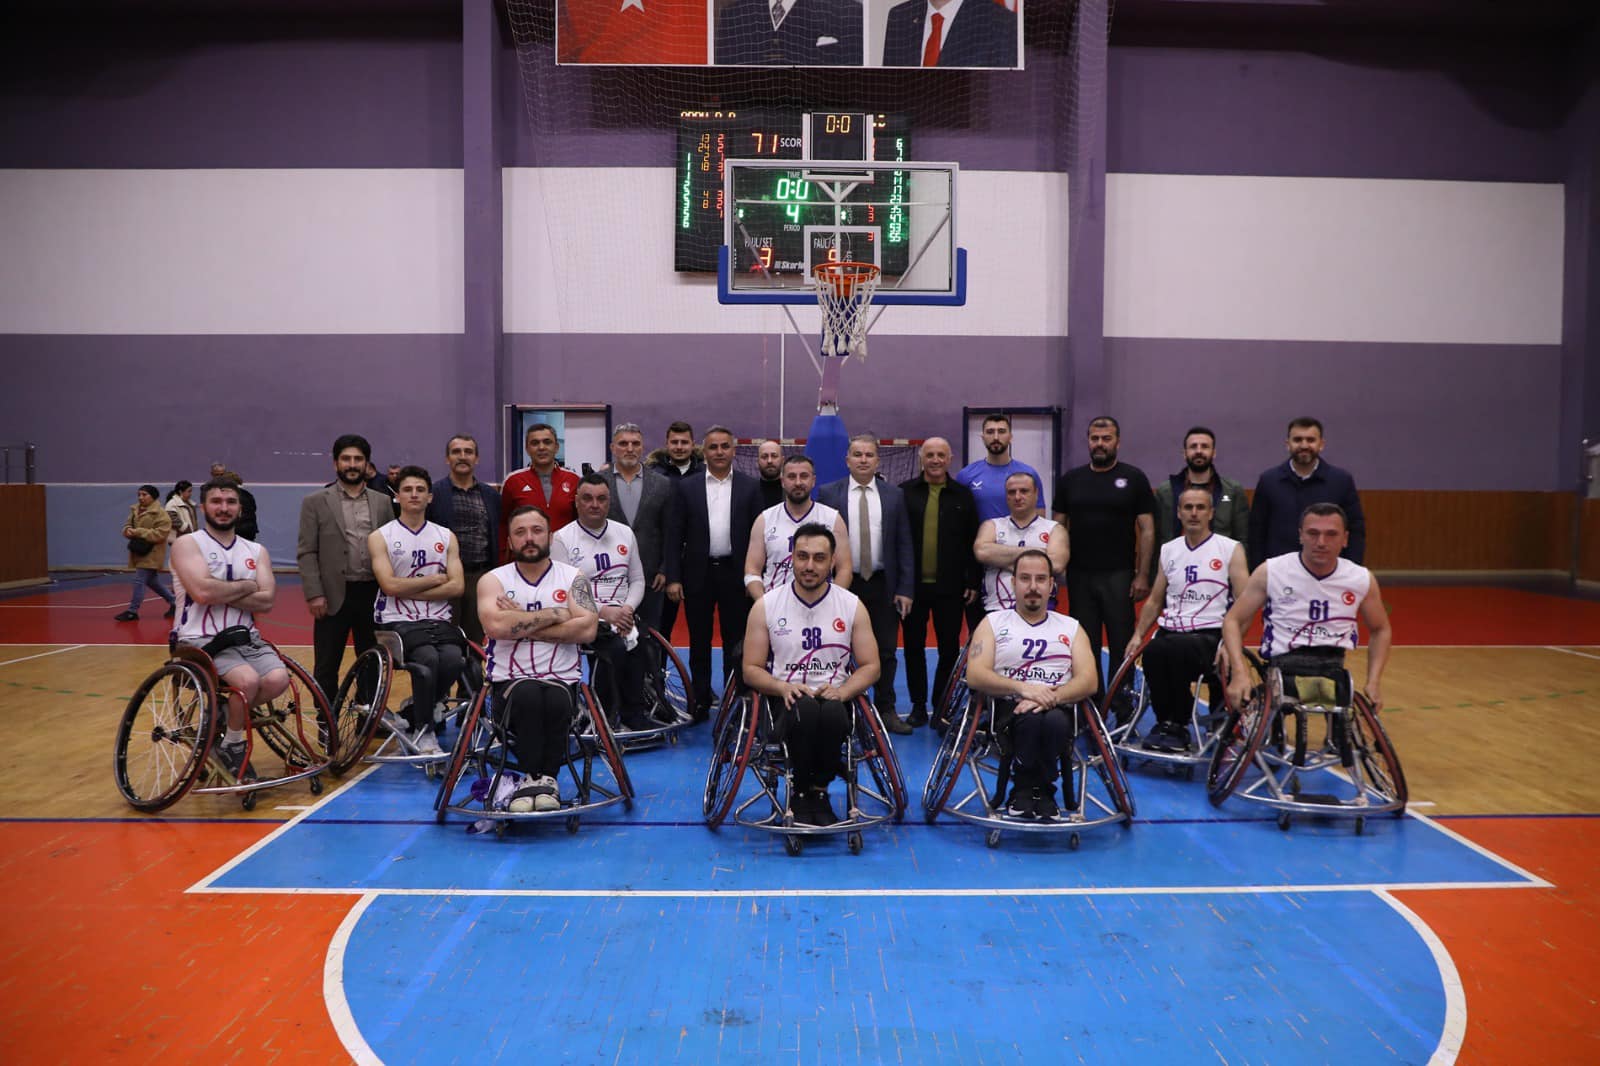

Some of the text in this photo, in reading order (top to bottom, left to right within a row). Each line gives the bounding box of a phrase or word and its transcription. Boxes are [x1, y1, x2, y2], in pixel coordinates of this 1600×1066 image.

[825, 115, 850, 134] 0:0
[751, 133, 803, 153] 71 SCOR
[776, 178, 809, 200] 0:0
[786, 203, 800, 224] 4
[783, 224, 800, 232] PERIOD
[760, 247, 772, 269] 3
[411, 549, 426, 568] 28
[594, 552, 611, 571] 10
[1184, 565, 1198, 583] 15
[1309, 599, 1329, 621] 61
[801, 627, 822, 650] 38
[1022, 638, 1048, 661] 22
